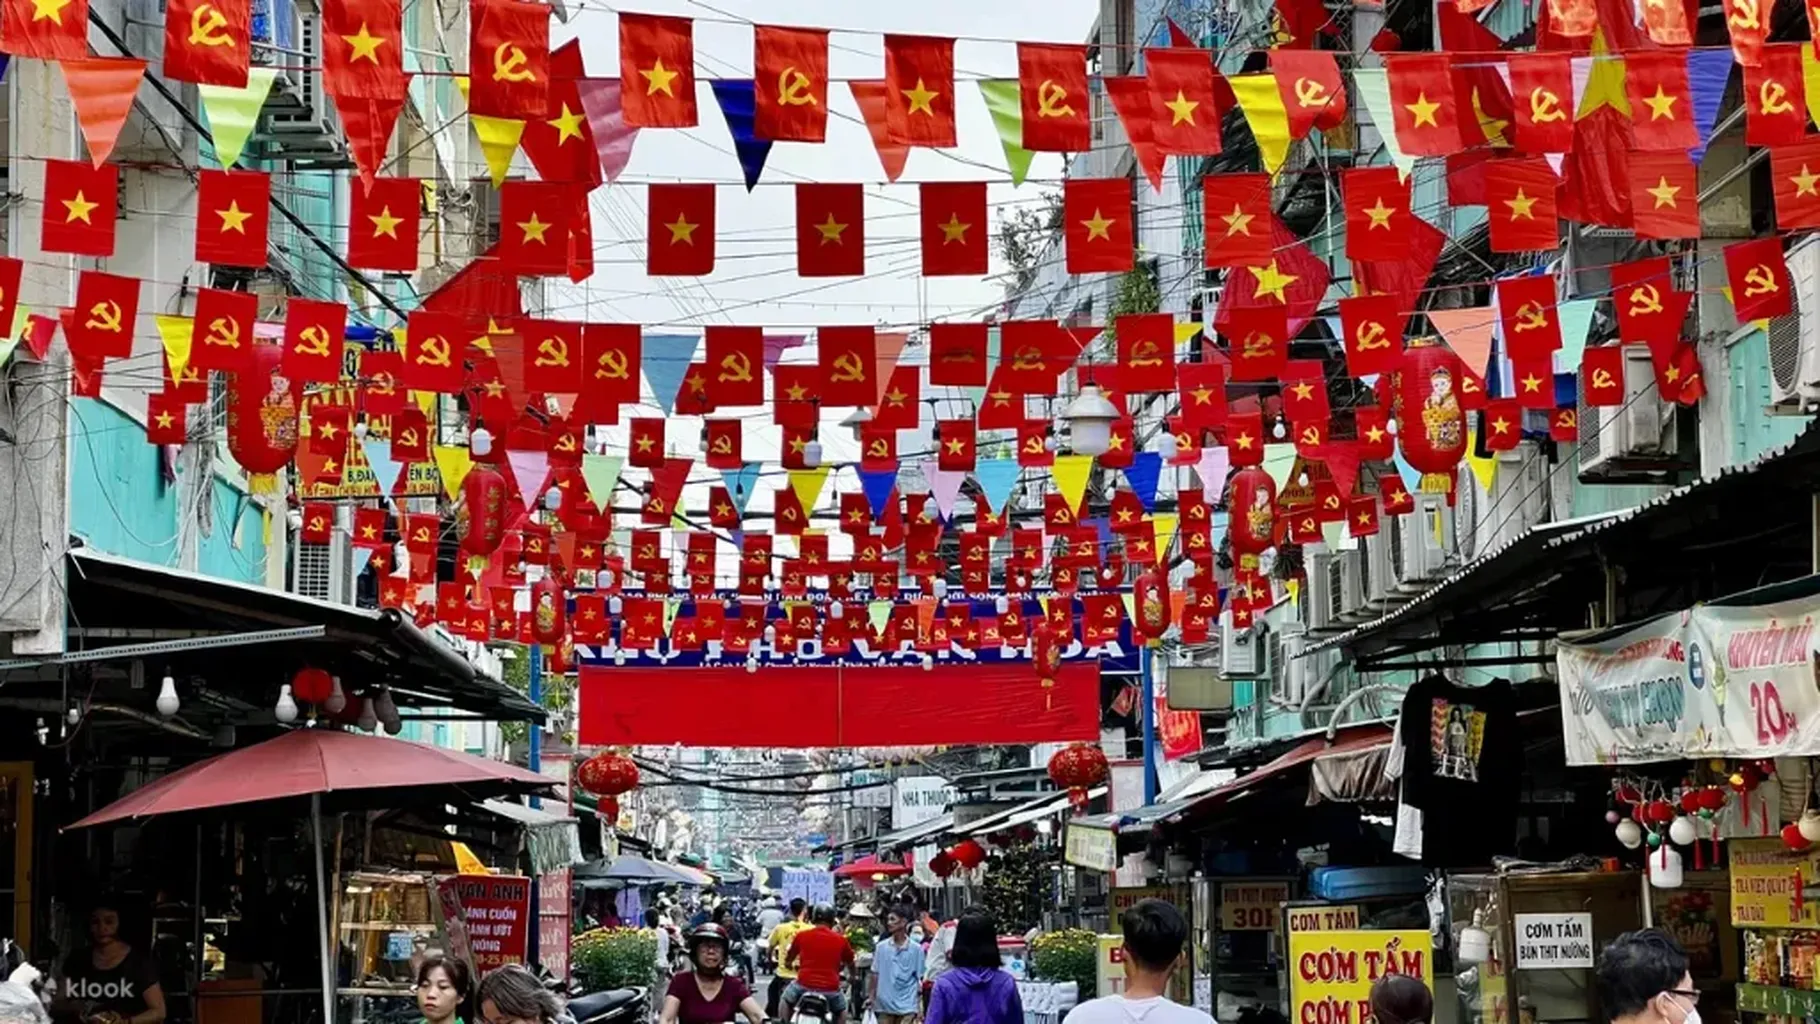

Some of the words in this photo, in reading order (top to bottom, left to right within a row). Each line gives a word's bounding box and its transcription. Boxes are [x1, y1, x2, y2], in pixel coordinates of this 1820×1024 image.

[857, 792, 888, 805] 115
[491, 883, 524, 900] ANH
[465, 907, 487, 919] ÁNH
[1525, 921, 1553, 939] CƠM
[1556, 917, 1583, 938] TẤM
[1299, 946, 1358, 984] CƠM
[1364, 936, 1426, 981] TẤM
[1520, 941, 1538, 960] BÚN
[1540, 945, 1559, 963] THỊT
[1300, 996, 1351, 1024] CƠM
